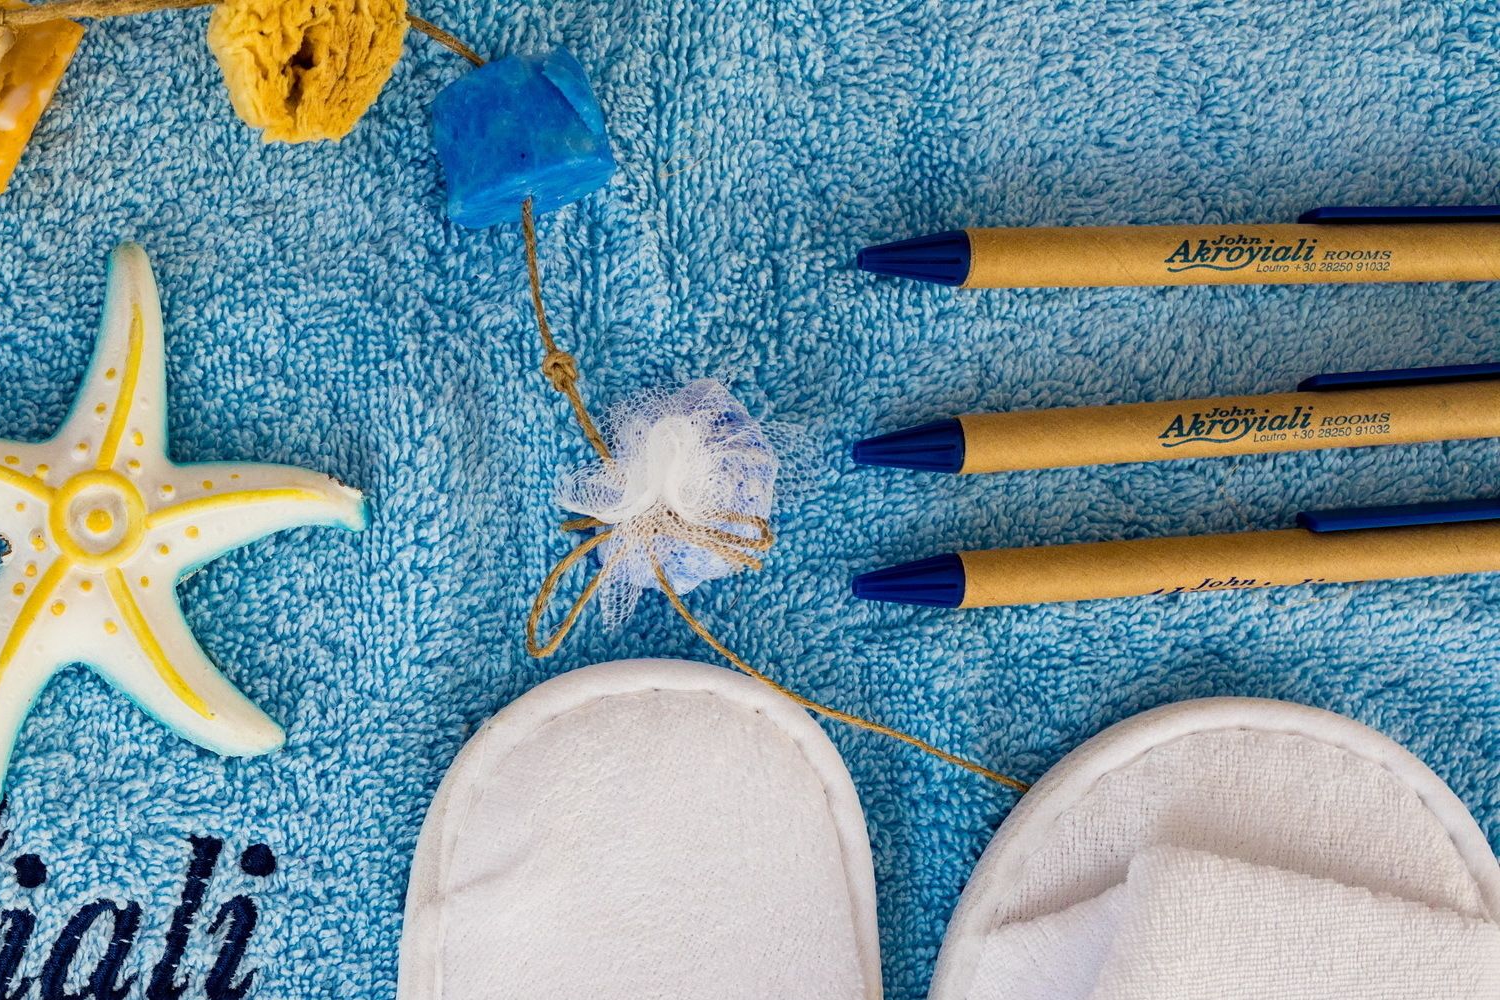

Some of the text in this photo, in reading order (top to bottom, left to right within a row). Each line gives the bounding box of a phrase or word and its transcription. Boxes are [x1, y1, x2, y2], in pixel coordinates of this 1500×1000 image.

[1211, 234, 1262, 245] John
[1164, 239, 1392, 272] Akroyiali ROOMS
[1256, 261, 1390, 273] Loutro +30 28250 91032
[1205, 406, 1255, 419] John
[1158, 406, 1391, 447] Akroyiali ROOMS
[1254, 424, 1391, 443] Loutro +30 28250 91032
[1191, 577, 1256, 590] John
